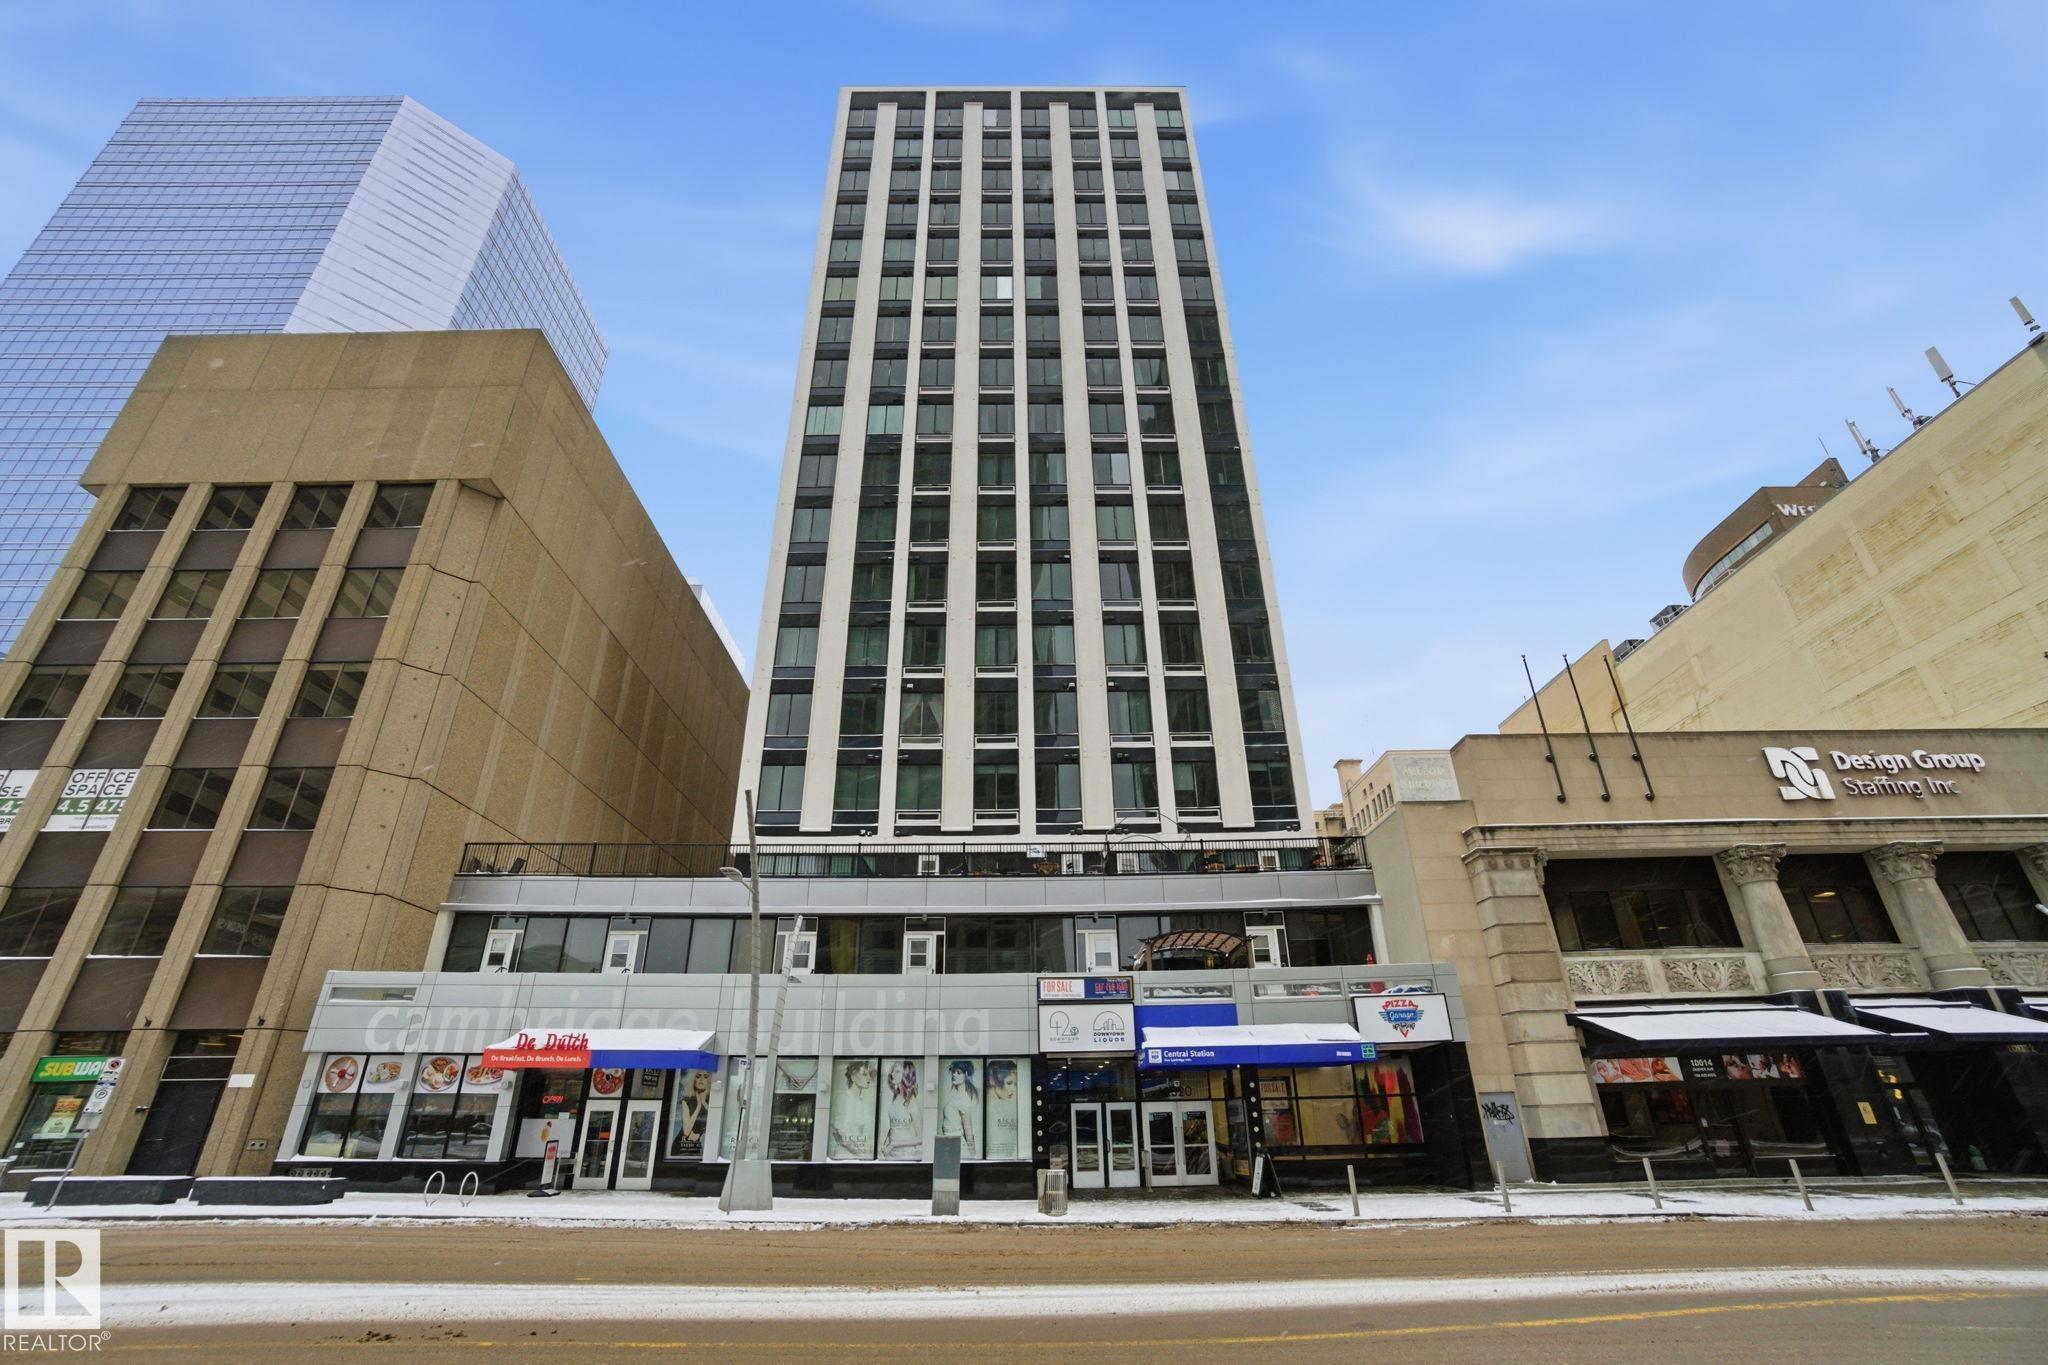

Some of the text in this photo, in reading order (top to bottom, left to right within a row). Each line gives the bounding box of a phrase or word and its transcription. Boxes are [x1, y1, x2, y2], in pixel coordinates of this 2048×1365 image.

[1829, 749, 1986, 774] Design Group
[71, 771, 137, 784] OFFICE
[64, 784, 126, 796] SPACE
[1842, 776, 1961, 799] Staffing Inc
[1043, 981, 1073, 993] FOR SALE
[1382, 999, 1418, 1010] PIZZA
[730, 988, 990, 1056] building
[1389, 1011, 1415, 1021] Garage
[513, 1032, 589, 1050] De Dutch
[1163, 1049, 1215, 1058] Central Station
[1690, 1058, 1713, 1067] 10014
